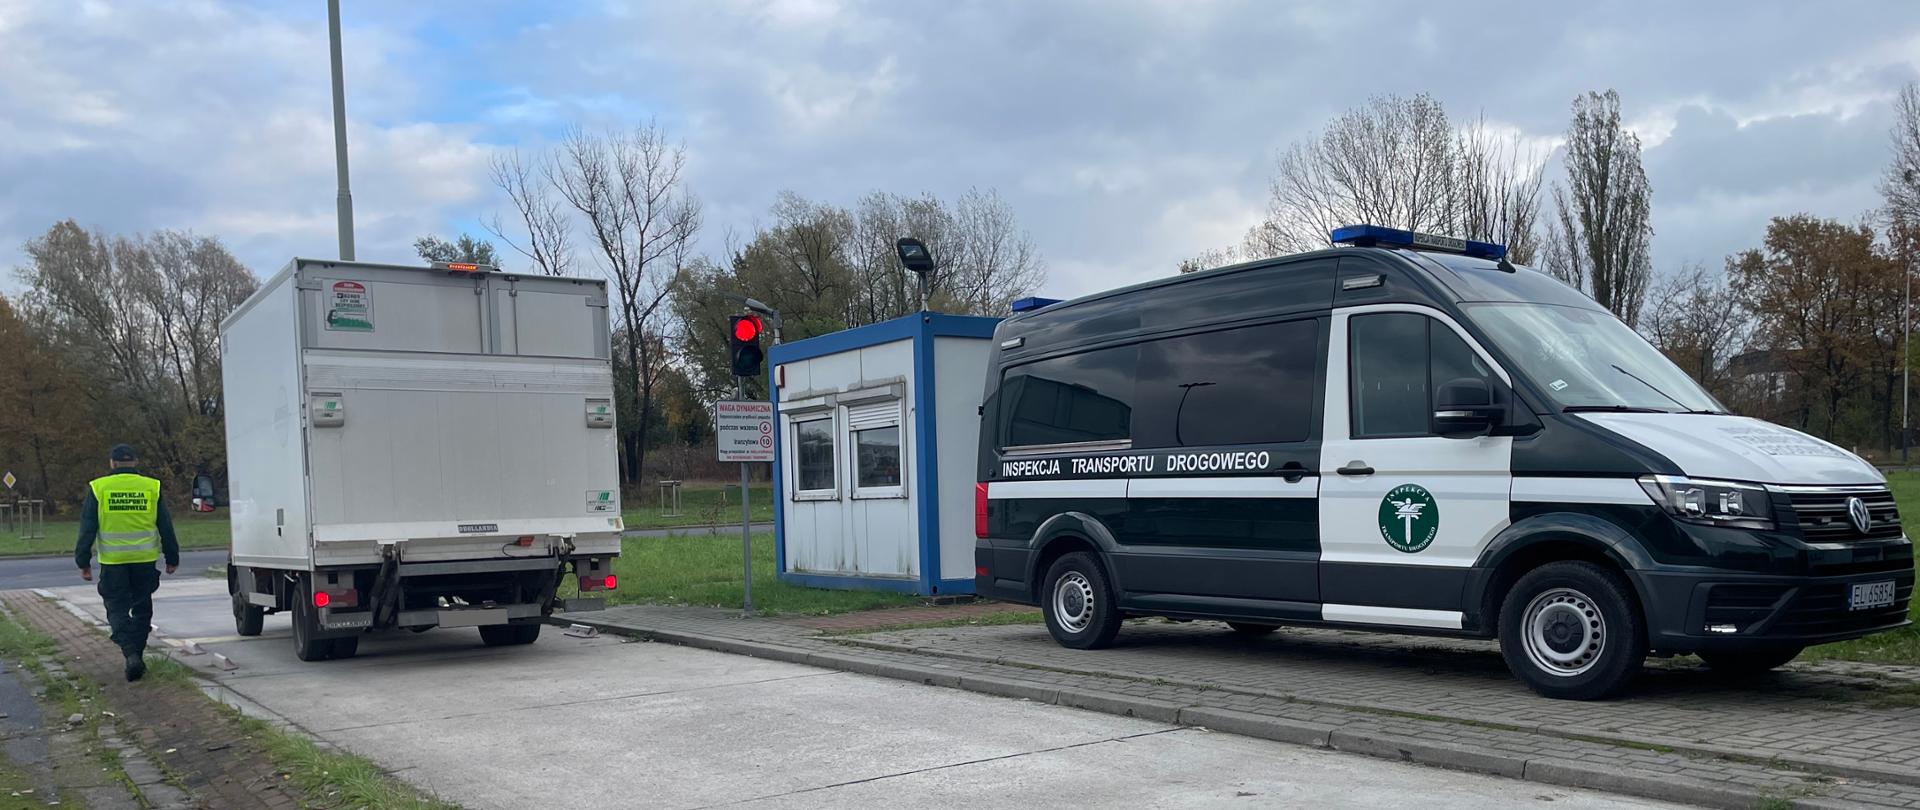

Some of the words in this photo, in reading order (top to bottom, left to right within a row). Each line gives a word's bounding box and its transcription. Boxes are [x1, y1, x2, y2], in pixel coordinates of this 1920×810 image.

[1002, 459, 1060, 477] INSPEKCJA
[1072, 456, 1154, 474] TRANSPORTU
[1167, 451, 1270, 472] DROGOWEGO
[1854, 585, 1865, 605] EL
